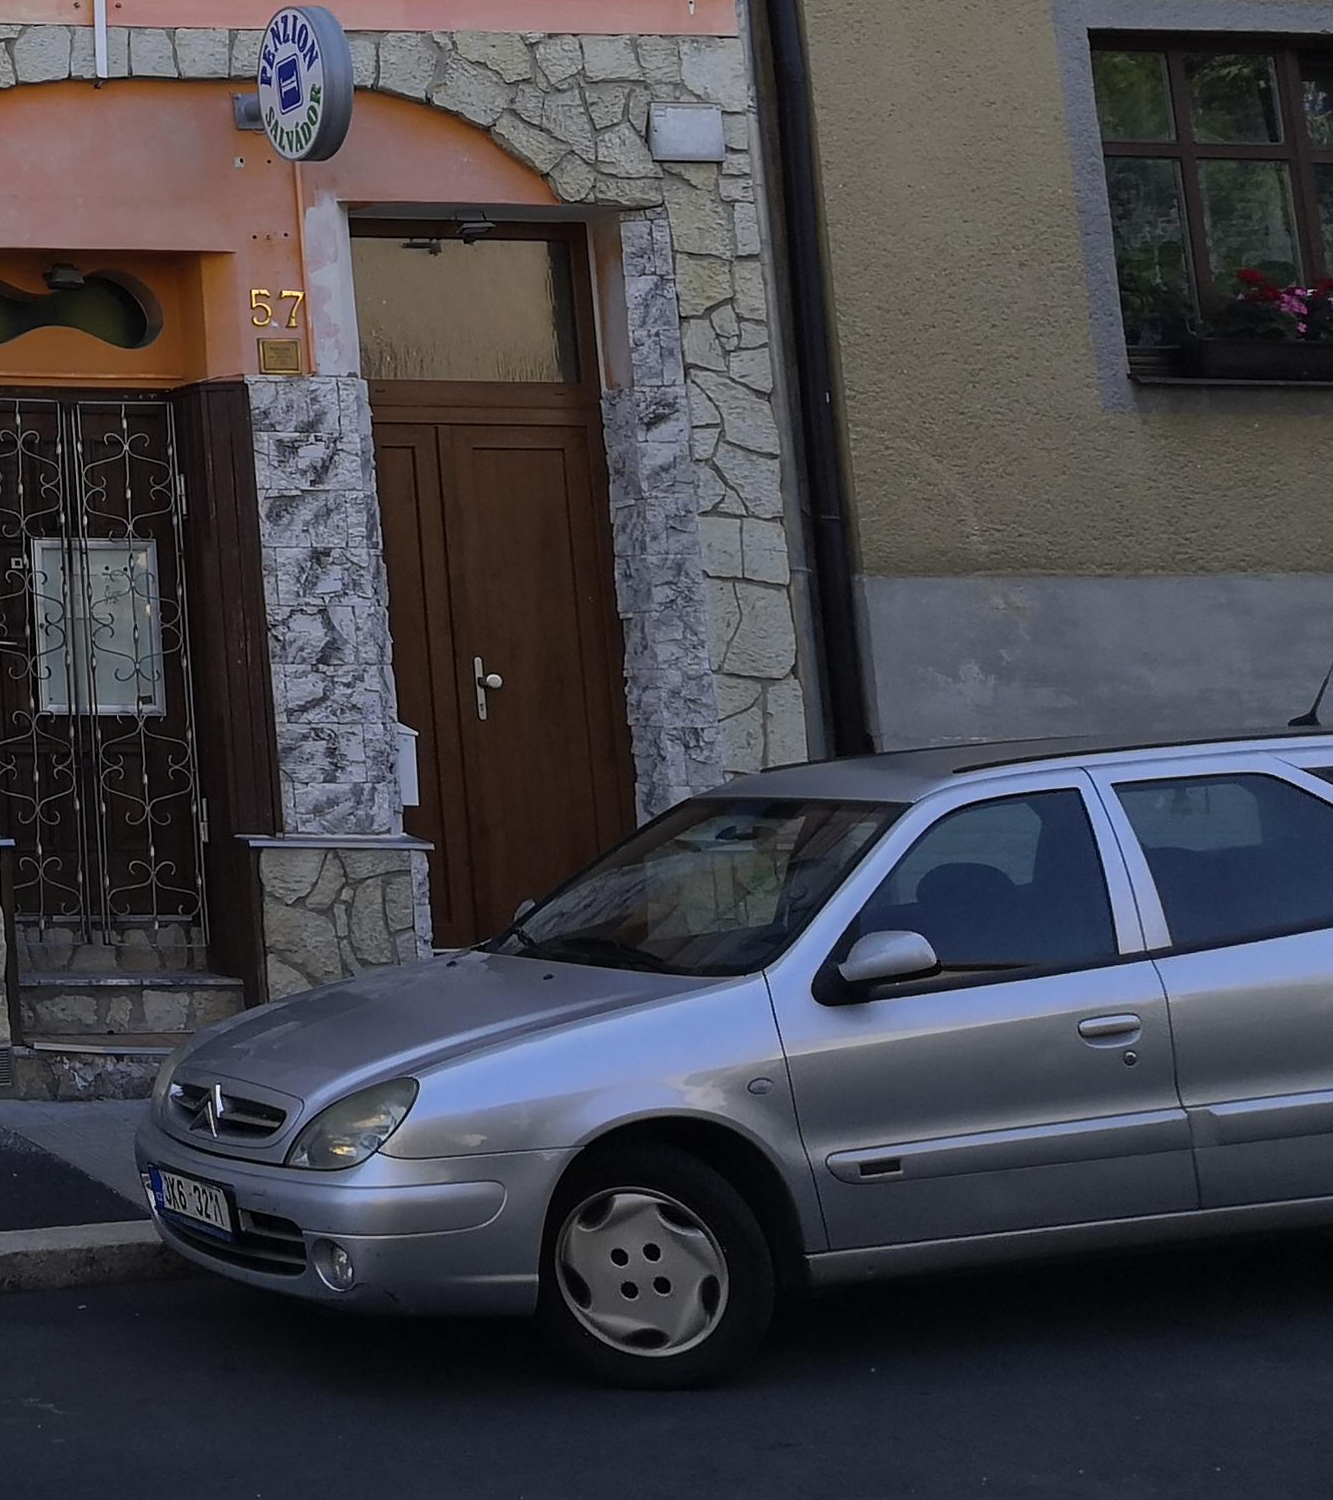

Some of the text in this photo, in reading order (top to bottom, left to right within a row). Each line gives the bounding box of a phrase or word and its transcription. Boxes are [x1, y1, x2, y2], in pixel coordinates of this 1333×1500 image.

[260, 14, 319, 88] PENZION
[265, 83, 322, 153] SALVÁDOR
[250, 288, 305, 328] 57
